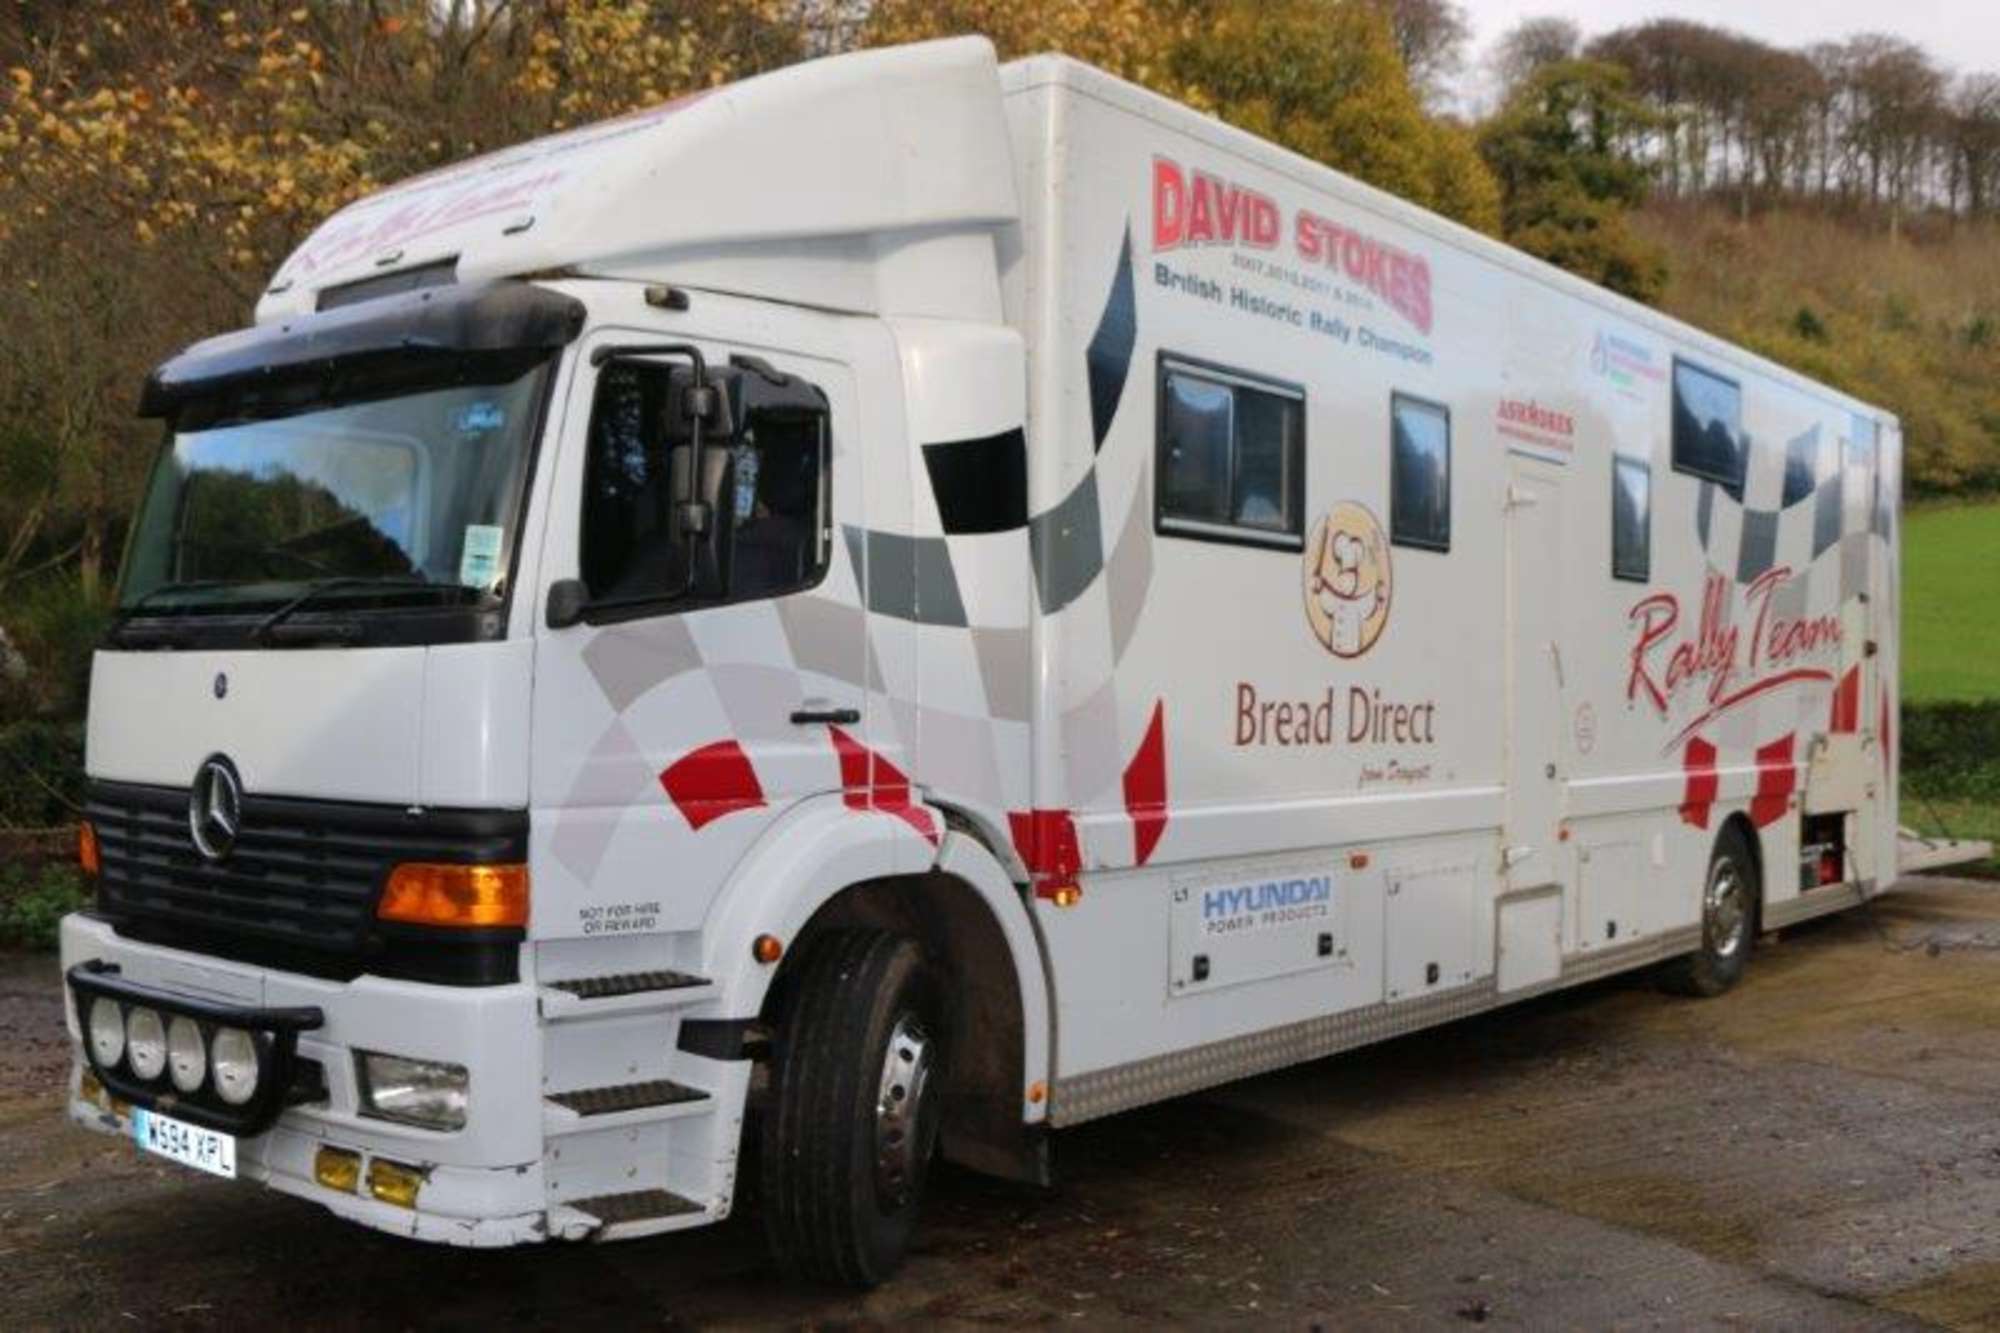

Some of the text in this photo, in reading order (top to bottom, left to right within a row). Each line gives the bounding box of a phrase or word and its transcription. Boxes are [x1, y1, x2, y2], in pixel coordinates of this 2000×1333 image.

[1151, 153, 1432, 336] DAVID STOKES
[1154, 263, 1222, 304] British
[1231, 287, 1302, 326] Historic
[1309, 310, 1349, 344] Rally
[1628, 565, 1842, 713] Rally Team
[1235, 682, 1436, 747] Bread Direct
[1204, 875, 1332, 919] HYUNDAI
[1206, 903, 1329, 936] POWER PRODUCTS
